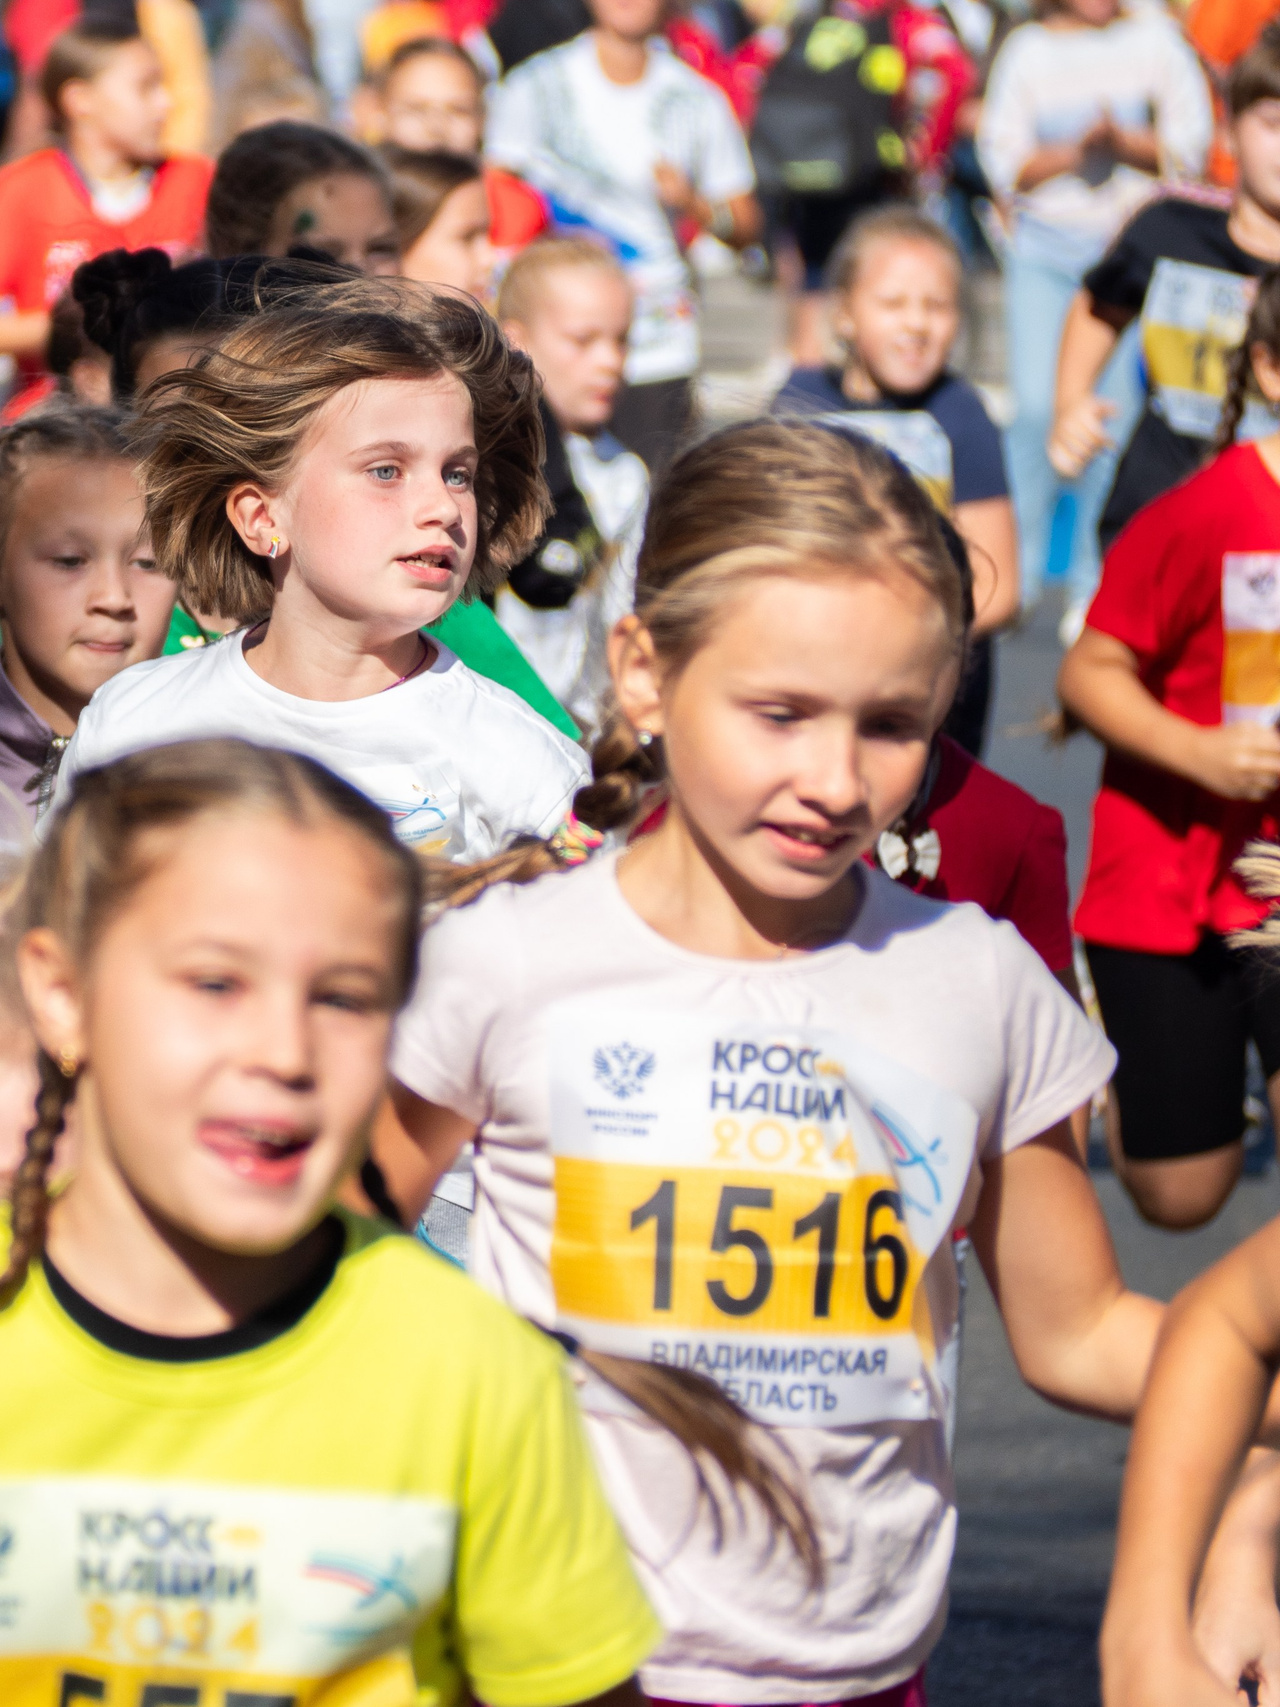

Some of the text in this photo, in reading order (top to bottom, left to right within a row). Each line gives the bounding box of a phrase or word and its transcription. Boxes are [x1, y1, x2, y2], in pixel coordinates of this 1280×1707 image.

[712, 1118, 859, 1169] 2024
[630, 1180, 907, 1321] 1516
[650, 1341, 888, 1375] ВЛАДИМИРСКАЯ
[722, 1377, 838, 1411] БЛАСТЬ
[87, 1601, 259, 1663] 2024
